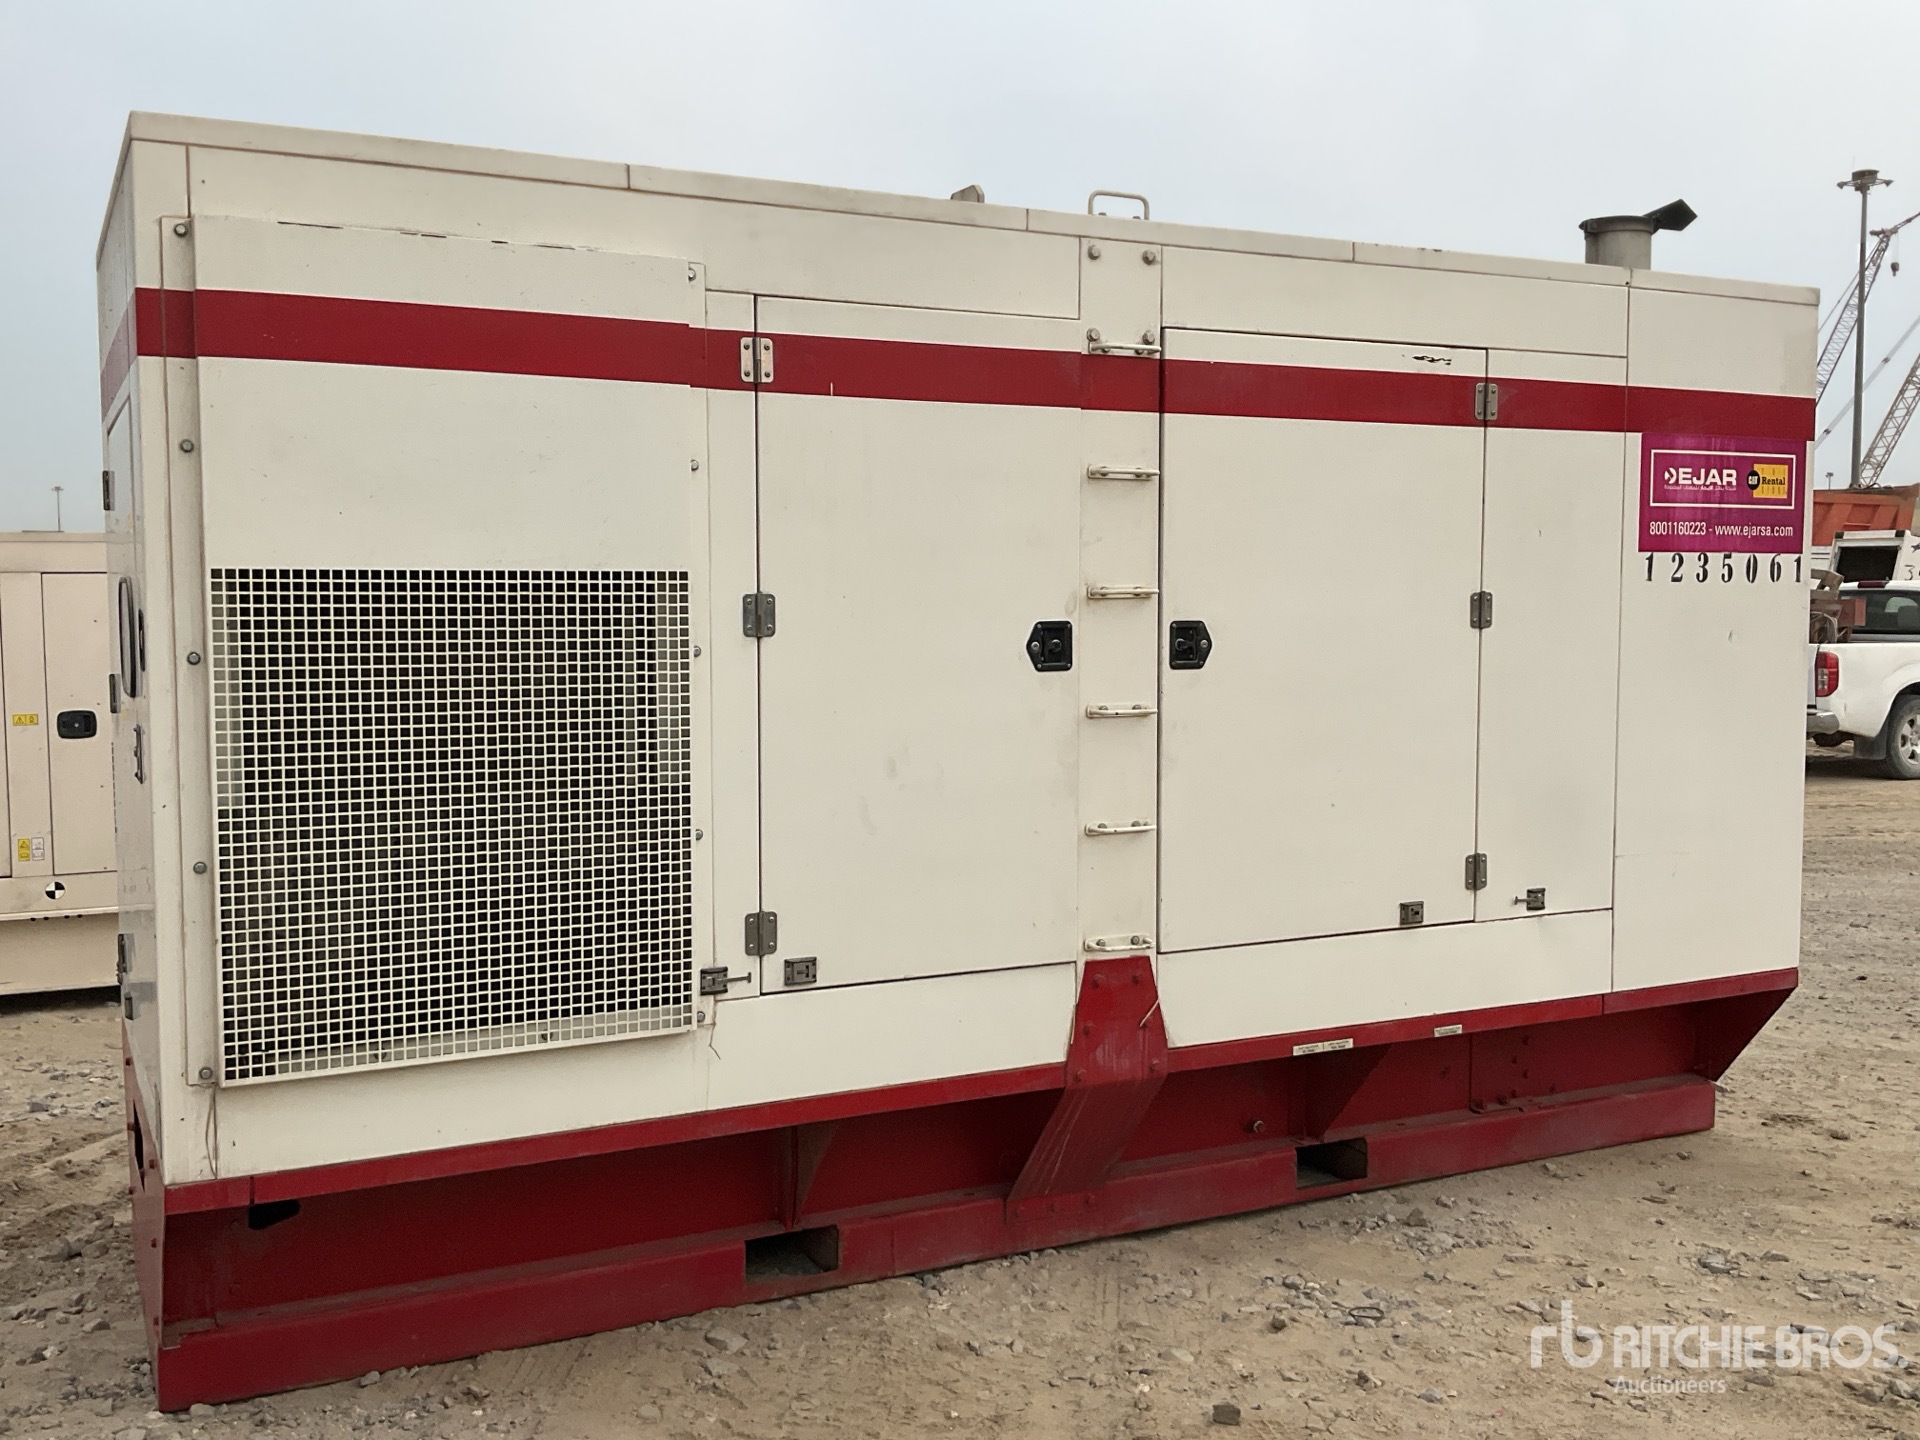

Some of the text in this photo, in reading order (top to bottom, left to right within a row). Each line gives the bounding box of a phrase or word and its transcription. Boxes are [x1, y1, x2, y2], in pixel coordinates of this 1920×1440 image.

[1761, 477, 1786, 486] Rental
[1650, 521, 1707, 536] 8001160223
[1715, 524, 1794, 539] www.ejarsa.com
